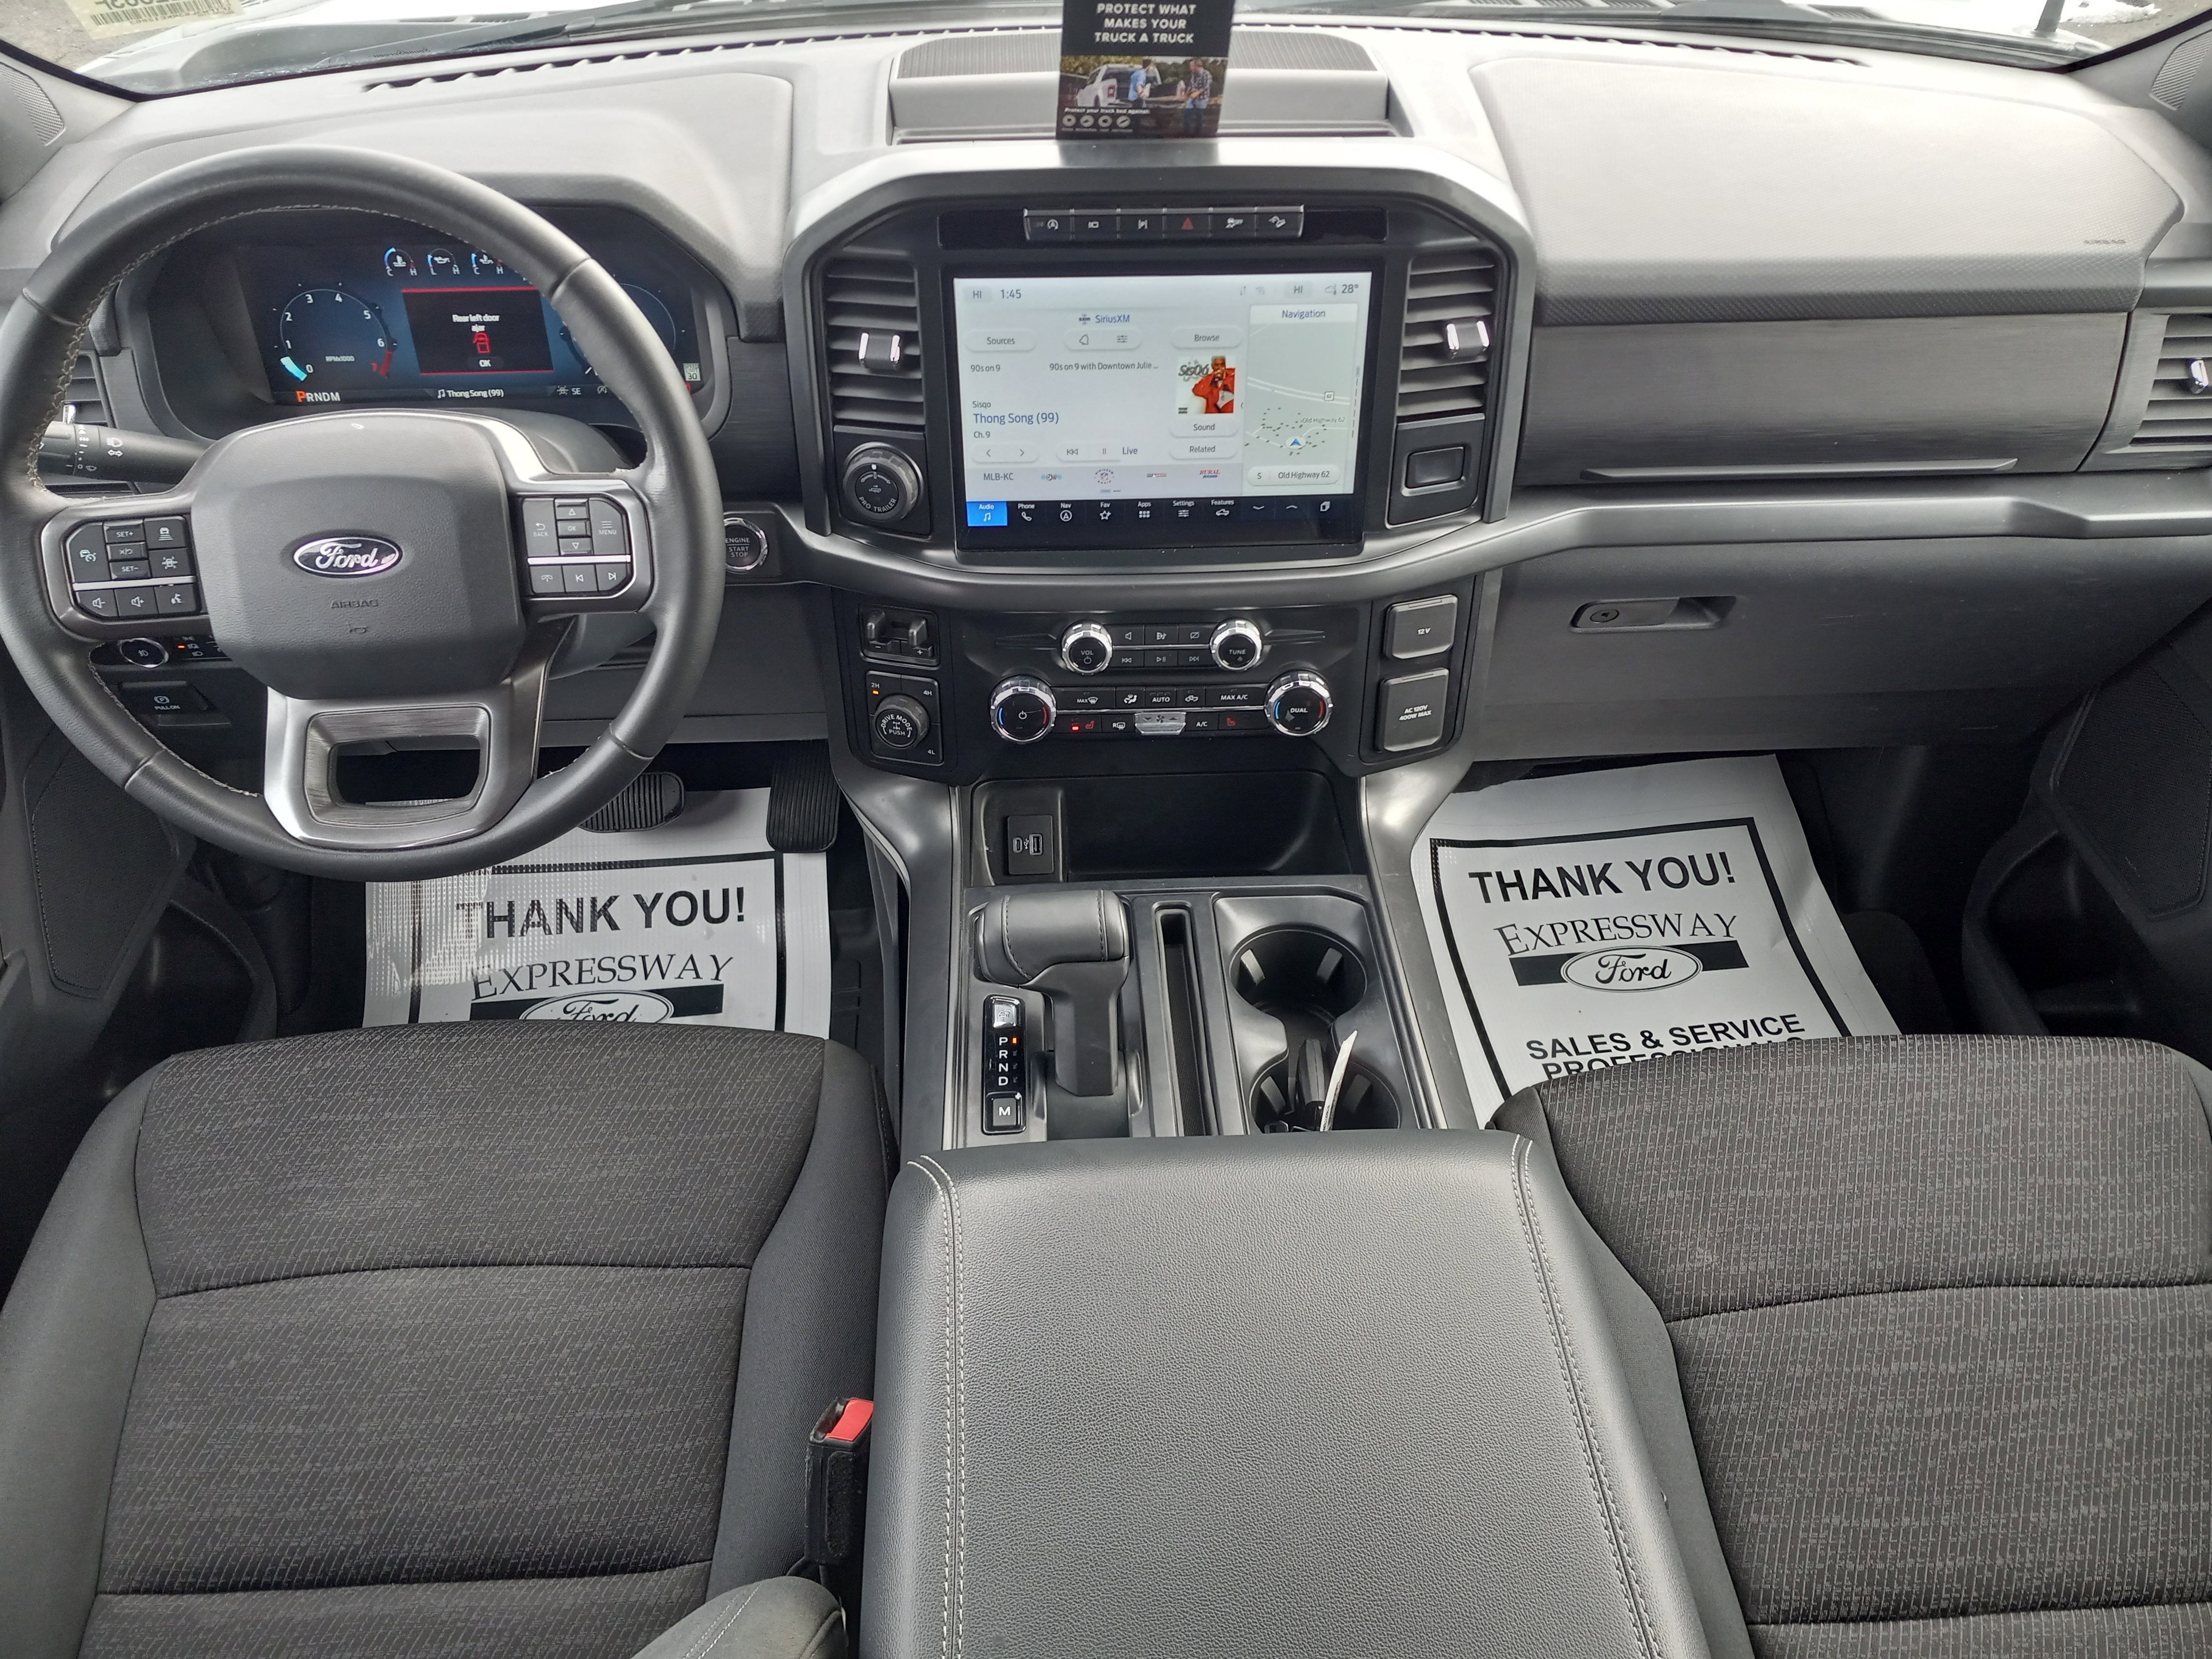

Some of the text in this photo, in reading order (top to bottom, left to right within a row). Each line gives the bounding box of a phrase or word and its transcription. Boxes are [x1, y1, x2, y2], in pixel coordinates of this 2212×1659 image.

[1097, 3, 1196, 15] PROTECT WHAT
[1105, 18, 1187, 29] MAKES YOUR
[1095, 32, 1194, 43] TRUCK A TRUCK
[386, 268, 394, 276] C
[410, 268, 417, 276] H
[973, 290, 982, 299] HI
[1000, 289, 1022, 300] 1:45
[1294, 286, 1303, 294] HI
[305, 294, 314, 304] 3
[335, 293, 343, 303] 4
[285, 312, 292, 322] 2
[363, 310, 371, 320] 5
[483, 313, 500, 322] door
[1095, 314, 1130, 324] SiriusXM
[1282, 310, 1326, 319] Navigation
[377, 338, 385, 348] 6
[986, 337, 1015, 345] Sources
[1194, 334, 1219, 342] Browse
[287, 340, 291, 349] 1
[306, 364, 314, 373] 0
[446, 390, 469, 398] Thong
[488, 389, 504, 397] (99)
[973, 411, 1059, 425] Thong Song (99)
[1122, 446, 1138, 455] Live
[983, 472, 1014, 481] MLB-KC
[1291, 471, 1320, 481] Highway
[859, 496, 897, 513] PRO TRAILER
[315, 542, 378, 569] Ford
[1413, 704, 1429, 712] 120V
[1399, 712, 1418, 721] 400W
[880, 714, 913, 732] DRIVE MODE
[1468, 851, 1736, 904] THANK YOU!
[456, 887, 745, 938] THANK YOU!
[1493, 911, 1739, 957] EXPRESSWAY
[1595, 953, 1671, 985] Ford
[470, 953, 733, 1001] EXPRESSWAY
[999, 1037, 1008, 1046] P
[1526, 1033, 1631, 1060] SALES
[1639, 1030, 1664, 1049] &
[1669, 1014, 1805, 1046] SERVICE
[999, 1050, 1008, 1058] R
[998, 1063, 1009, 1072] N
[998, 1076, 1009, 1086] D
[998, 1106, 1010, 1116] M
